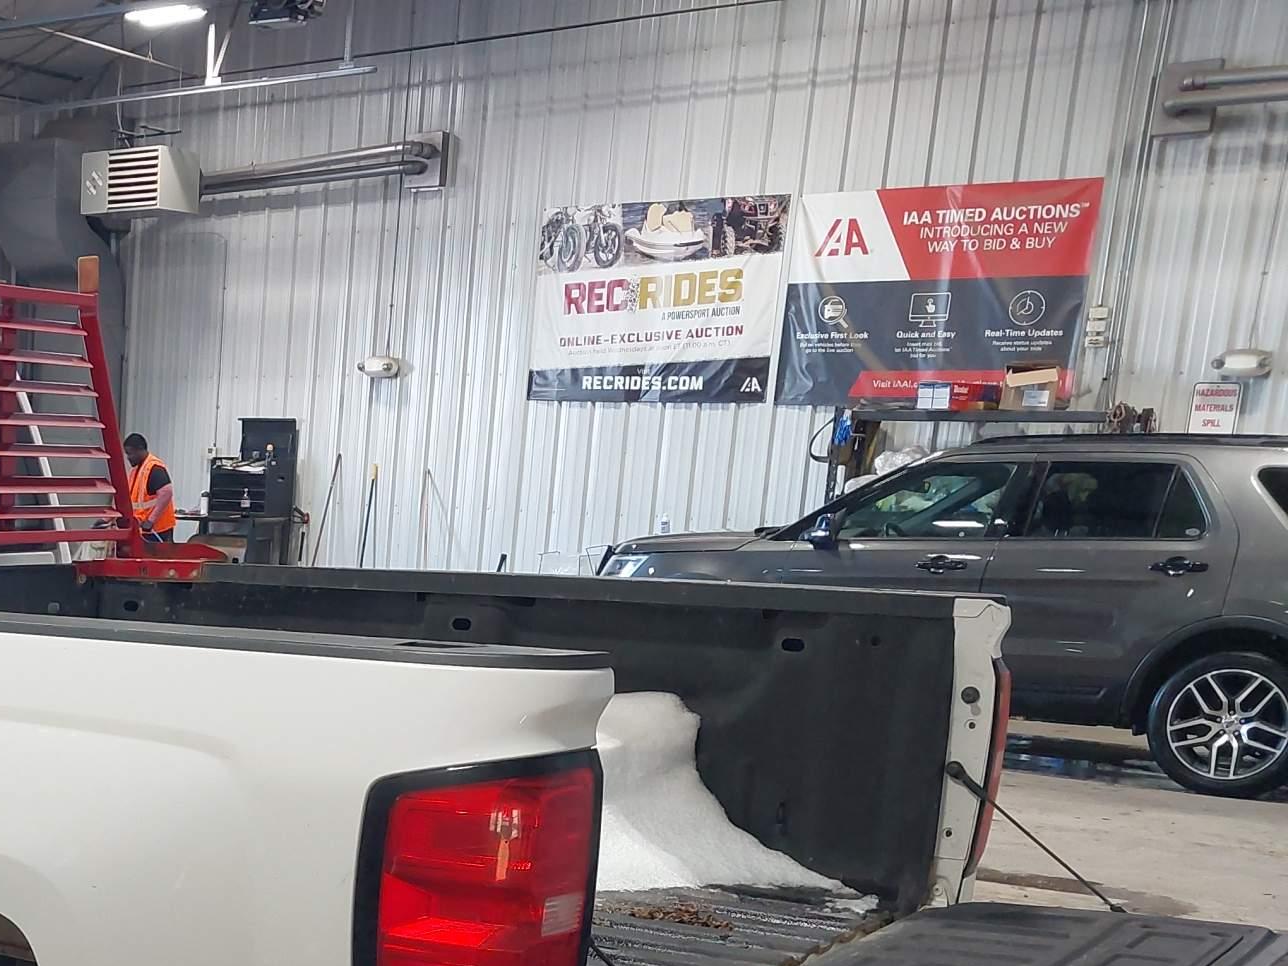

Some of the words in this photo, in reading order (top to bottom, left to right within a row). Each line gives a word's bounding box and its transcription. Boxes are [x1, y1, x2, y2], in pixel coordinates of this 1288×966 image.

[903, 209, 932, 225] IAA
[936, 207, 987, 224] TIMED
[920, 223, 1014, 239] INTRODUCING
[1017, 222, 1029, 235] A
[1033, 221, 1068, 234] NEW
[928, 239, 958, 253] WAY
[961, 239, 979, 252] TO
[983, 238, 1007, 250] BID
[1010, 237, 1021, 250] &
[1025, 236, 1057, 249] BUY
[667, 309, 710, 321] POWERSPORT
[712, 306, 740, 318] AUCTION
[560, 329, 682, 348] ONLINE-EXCLUSIVE
[688, 325, 744, 339] AUCTION
[796, 331, 829, 340] Exclusive
[830, 331, 848, 340] First
[850, 331, 869, 340] Look
[896, 330, 920, 339] Quick
[920, 330, 936, 338] and
[937, 330, 957, 340] Easy
[984, 329, 1026, 338] Real-Time
[1027, 328, 1064, 338] Updates
[582, 375, 704, 391] RECRIDES.COM
[872, 379, 892, 388] Visit
